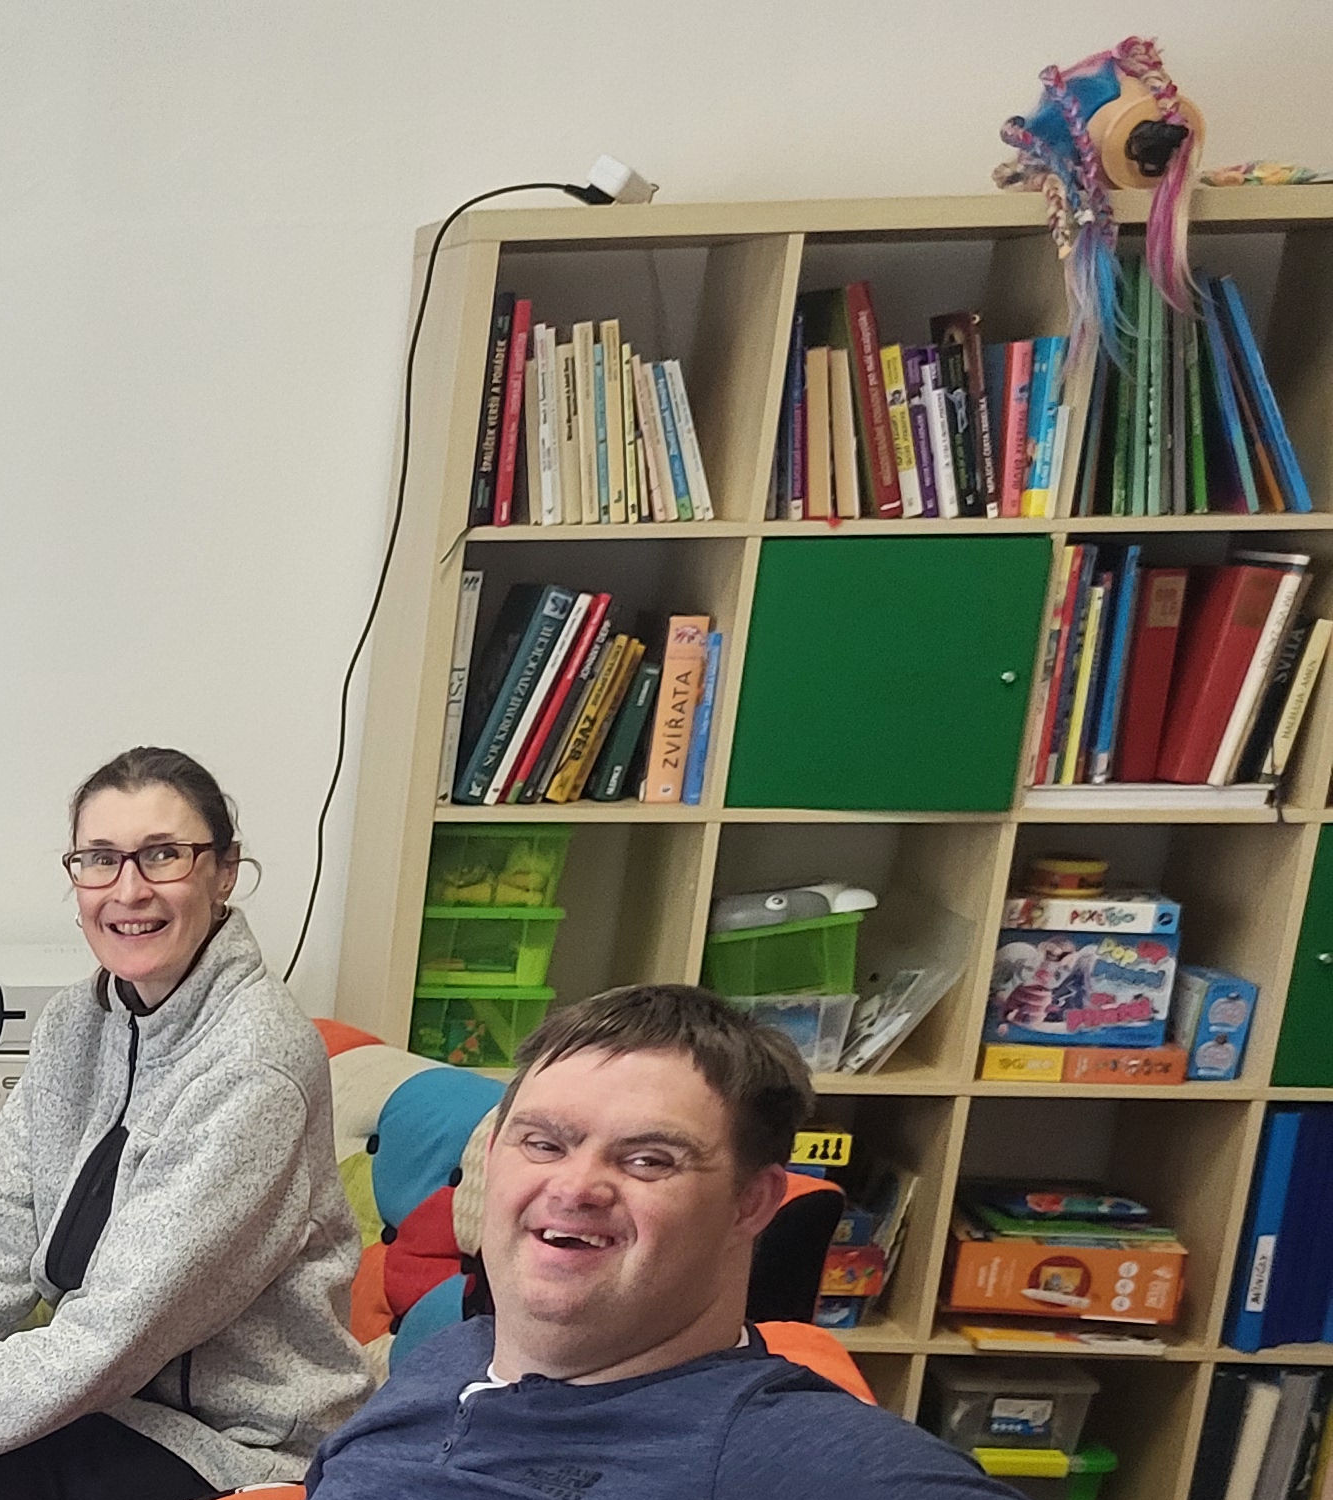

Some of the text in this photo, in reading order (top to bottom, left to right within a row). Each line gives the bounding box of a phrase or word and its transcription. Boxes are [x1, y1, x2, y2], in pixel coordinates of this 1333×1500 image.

[492, 338, 507, 384] POHÁDEK
[491, 384, 501, 394] A
[482, 427, 497, 472] ŠPALÍČEK
[661, 669, 693, 770] ZVÍŘATA
